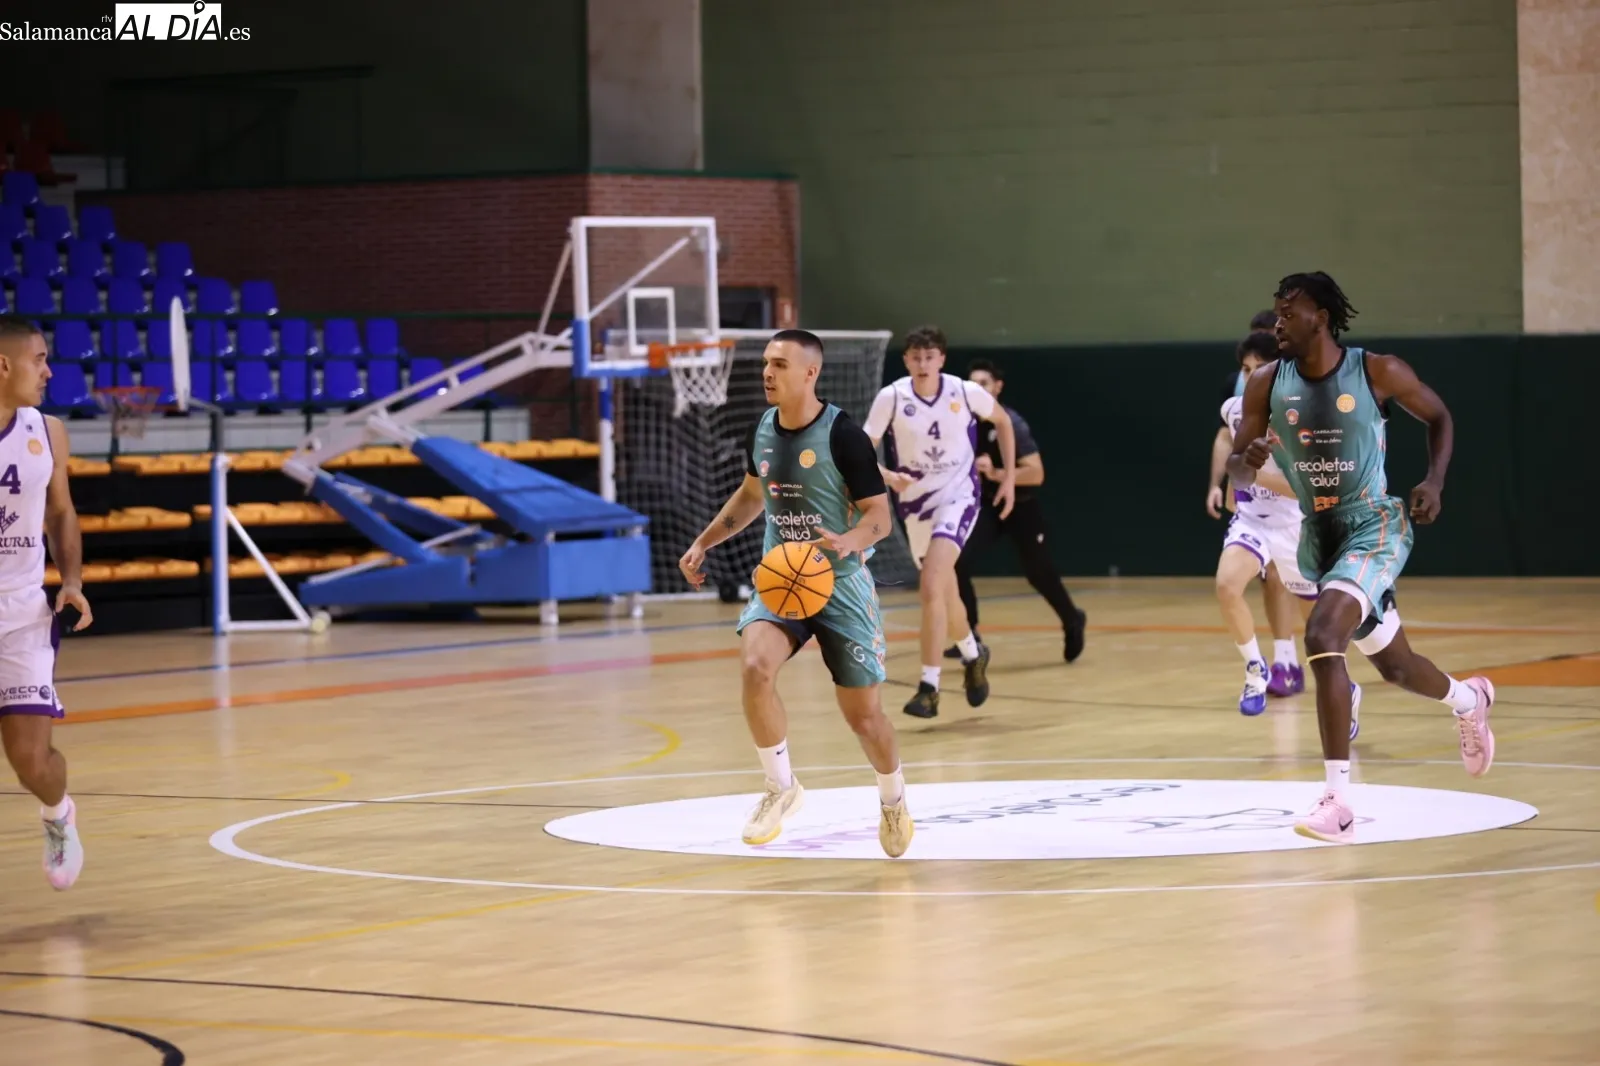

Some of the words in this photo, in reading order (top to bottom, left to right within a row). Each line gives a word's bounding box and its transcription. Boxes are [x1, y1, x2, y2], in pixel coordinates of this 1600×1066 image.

[927, 420, 941, 440] 4
[1294, 457, 1355, 472] recoletas
[0, 464, 21, 495] 4
[1309, 473, 1340, 487] salud
[779, 526, 811, 541] salud
